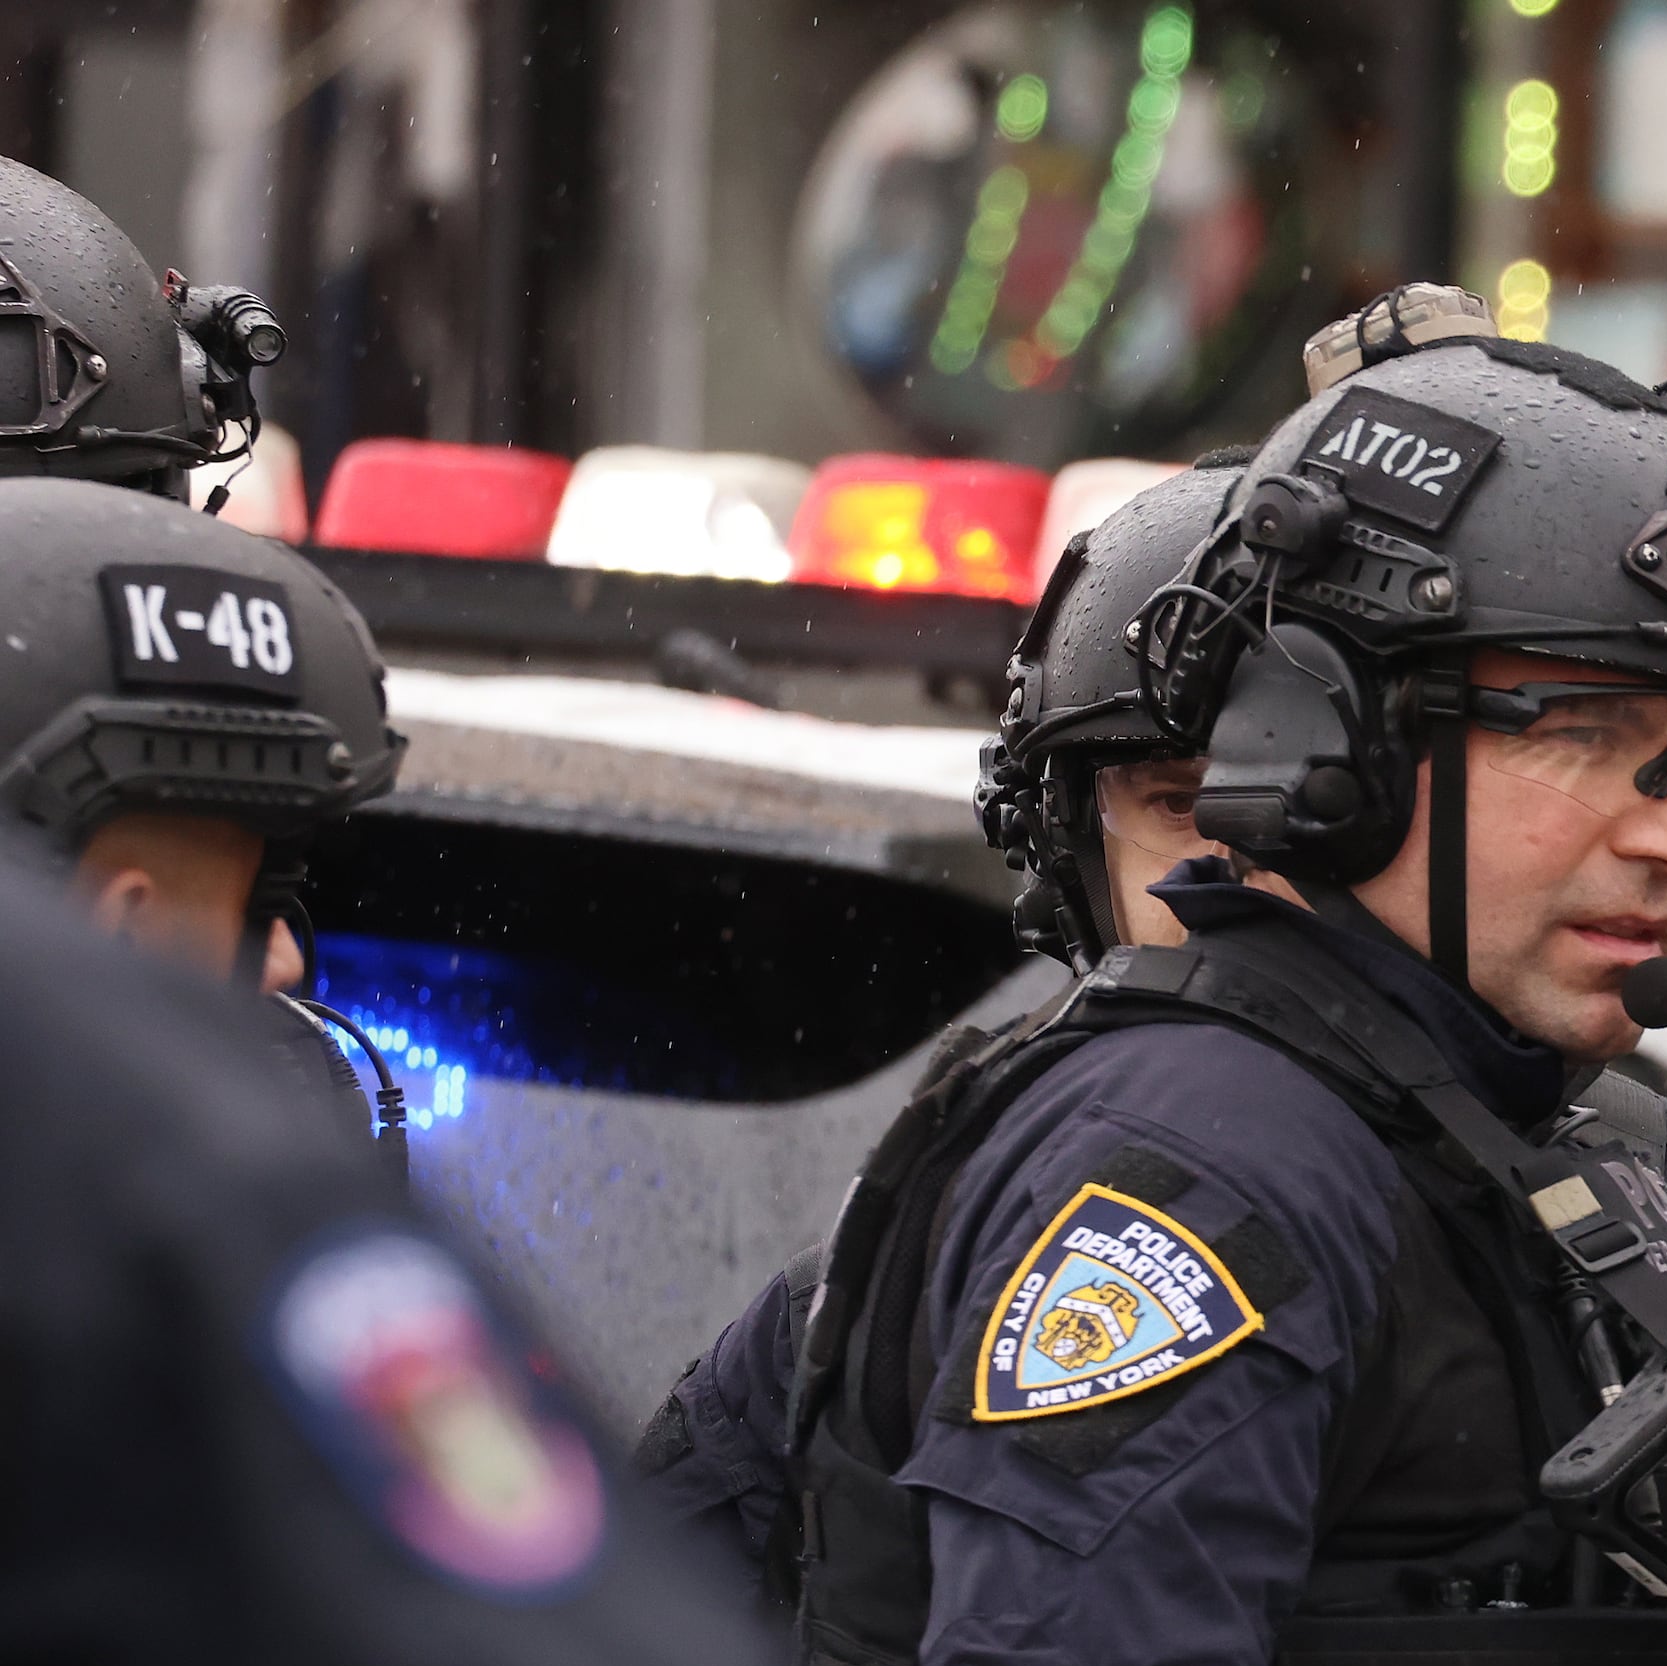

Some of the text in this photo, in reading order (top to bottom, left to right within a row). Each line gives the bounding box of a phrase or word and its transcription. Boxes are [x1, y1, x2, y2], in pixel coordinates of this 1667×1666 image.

[123, 583, 293, 676] K-48
[1061, 1226, 1213, 1342] DEPARTMENT
[1118, 1220, 1214, 1298] POLICE
[992, 1272, 1046, 1372] CITY OF
[1027, 1349, 1187, 1408] NEW YORK
